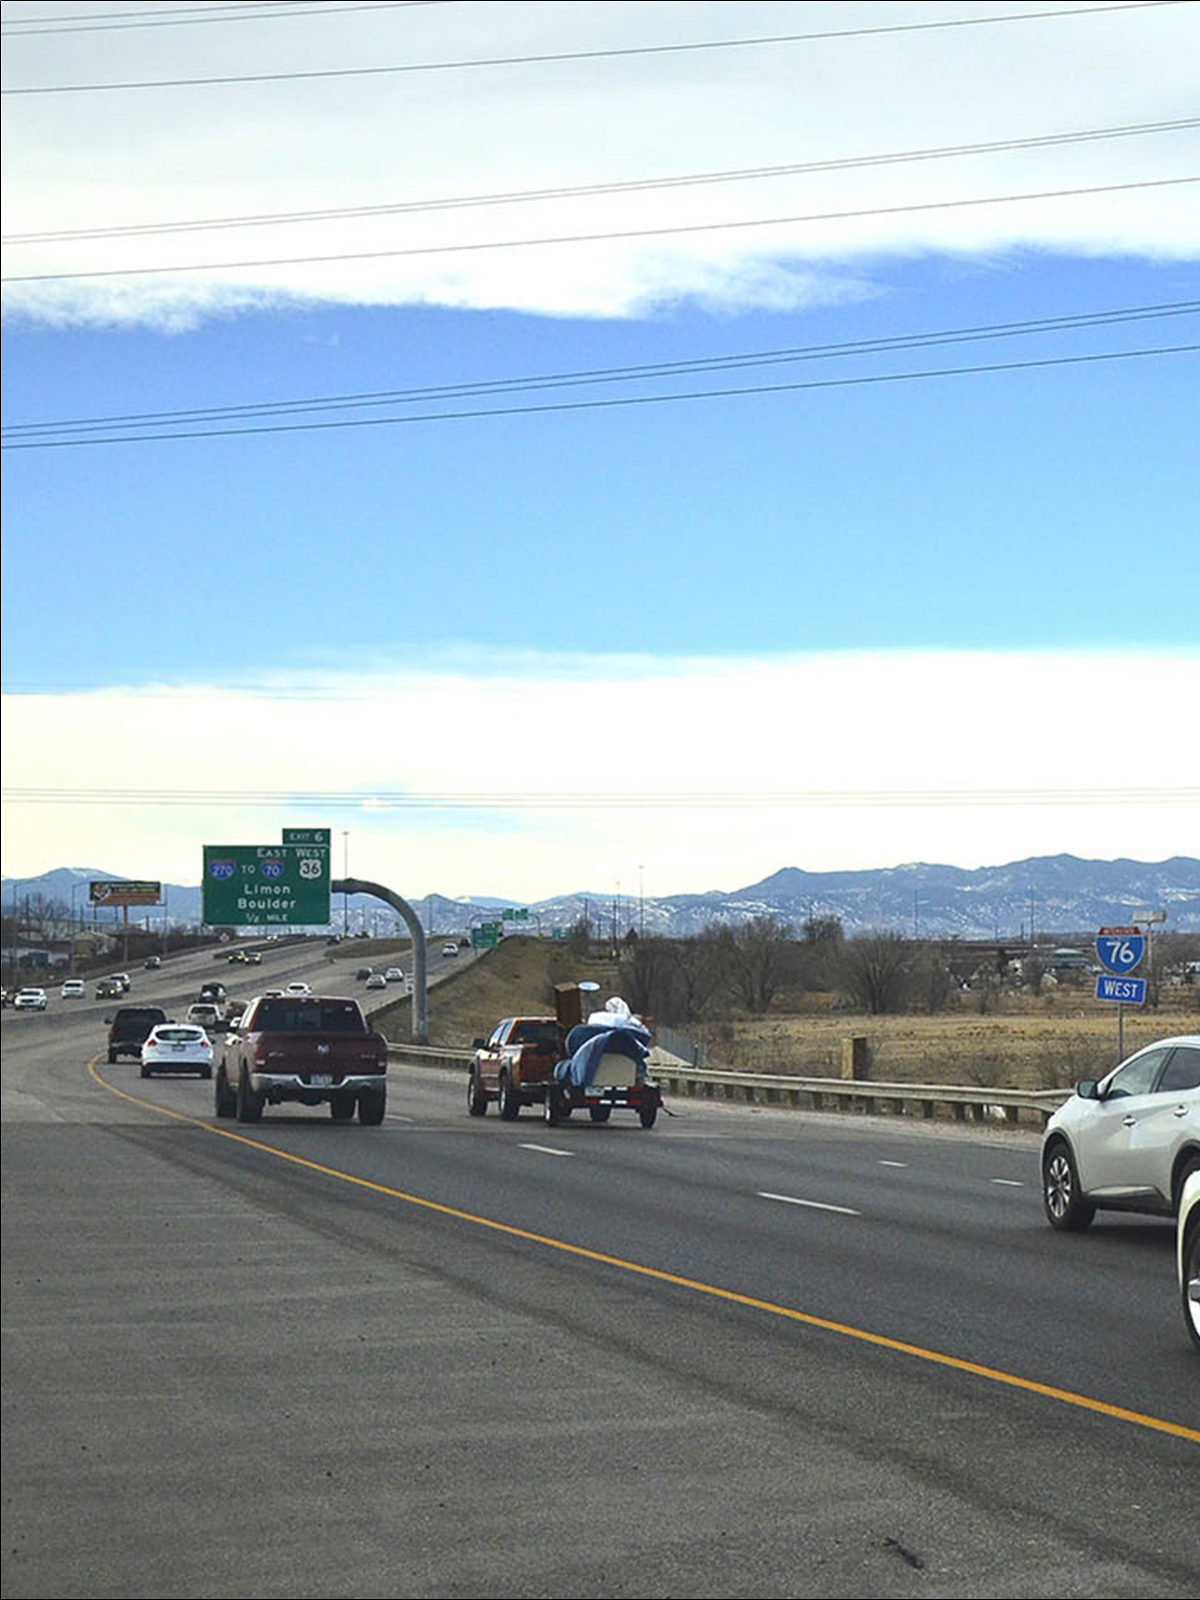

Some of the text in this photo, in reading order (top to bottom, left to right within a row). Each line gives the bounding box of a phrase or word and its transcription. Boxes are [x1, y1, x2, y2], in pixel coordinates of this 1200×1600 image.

[289, 831, 324, 842] EXIT 6
[256, 848, 326, 858] EAST WEST
[213, 862, 320, 877] 270 TO 70 36
[244, 884, 291, 895] Limon
[237, 898, 297, 909] Boulder
[267, 914, 289, 922] MILE
[1106, 942, 1135, 964] 76
[1104, 980, 1138, 998] WEST
